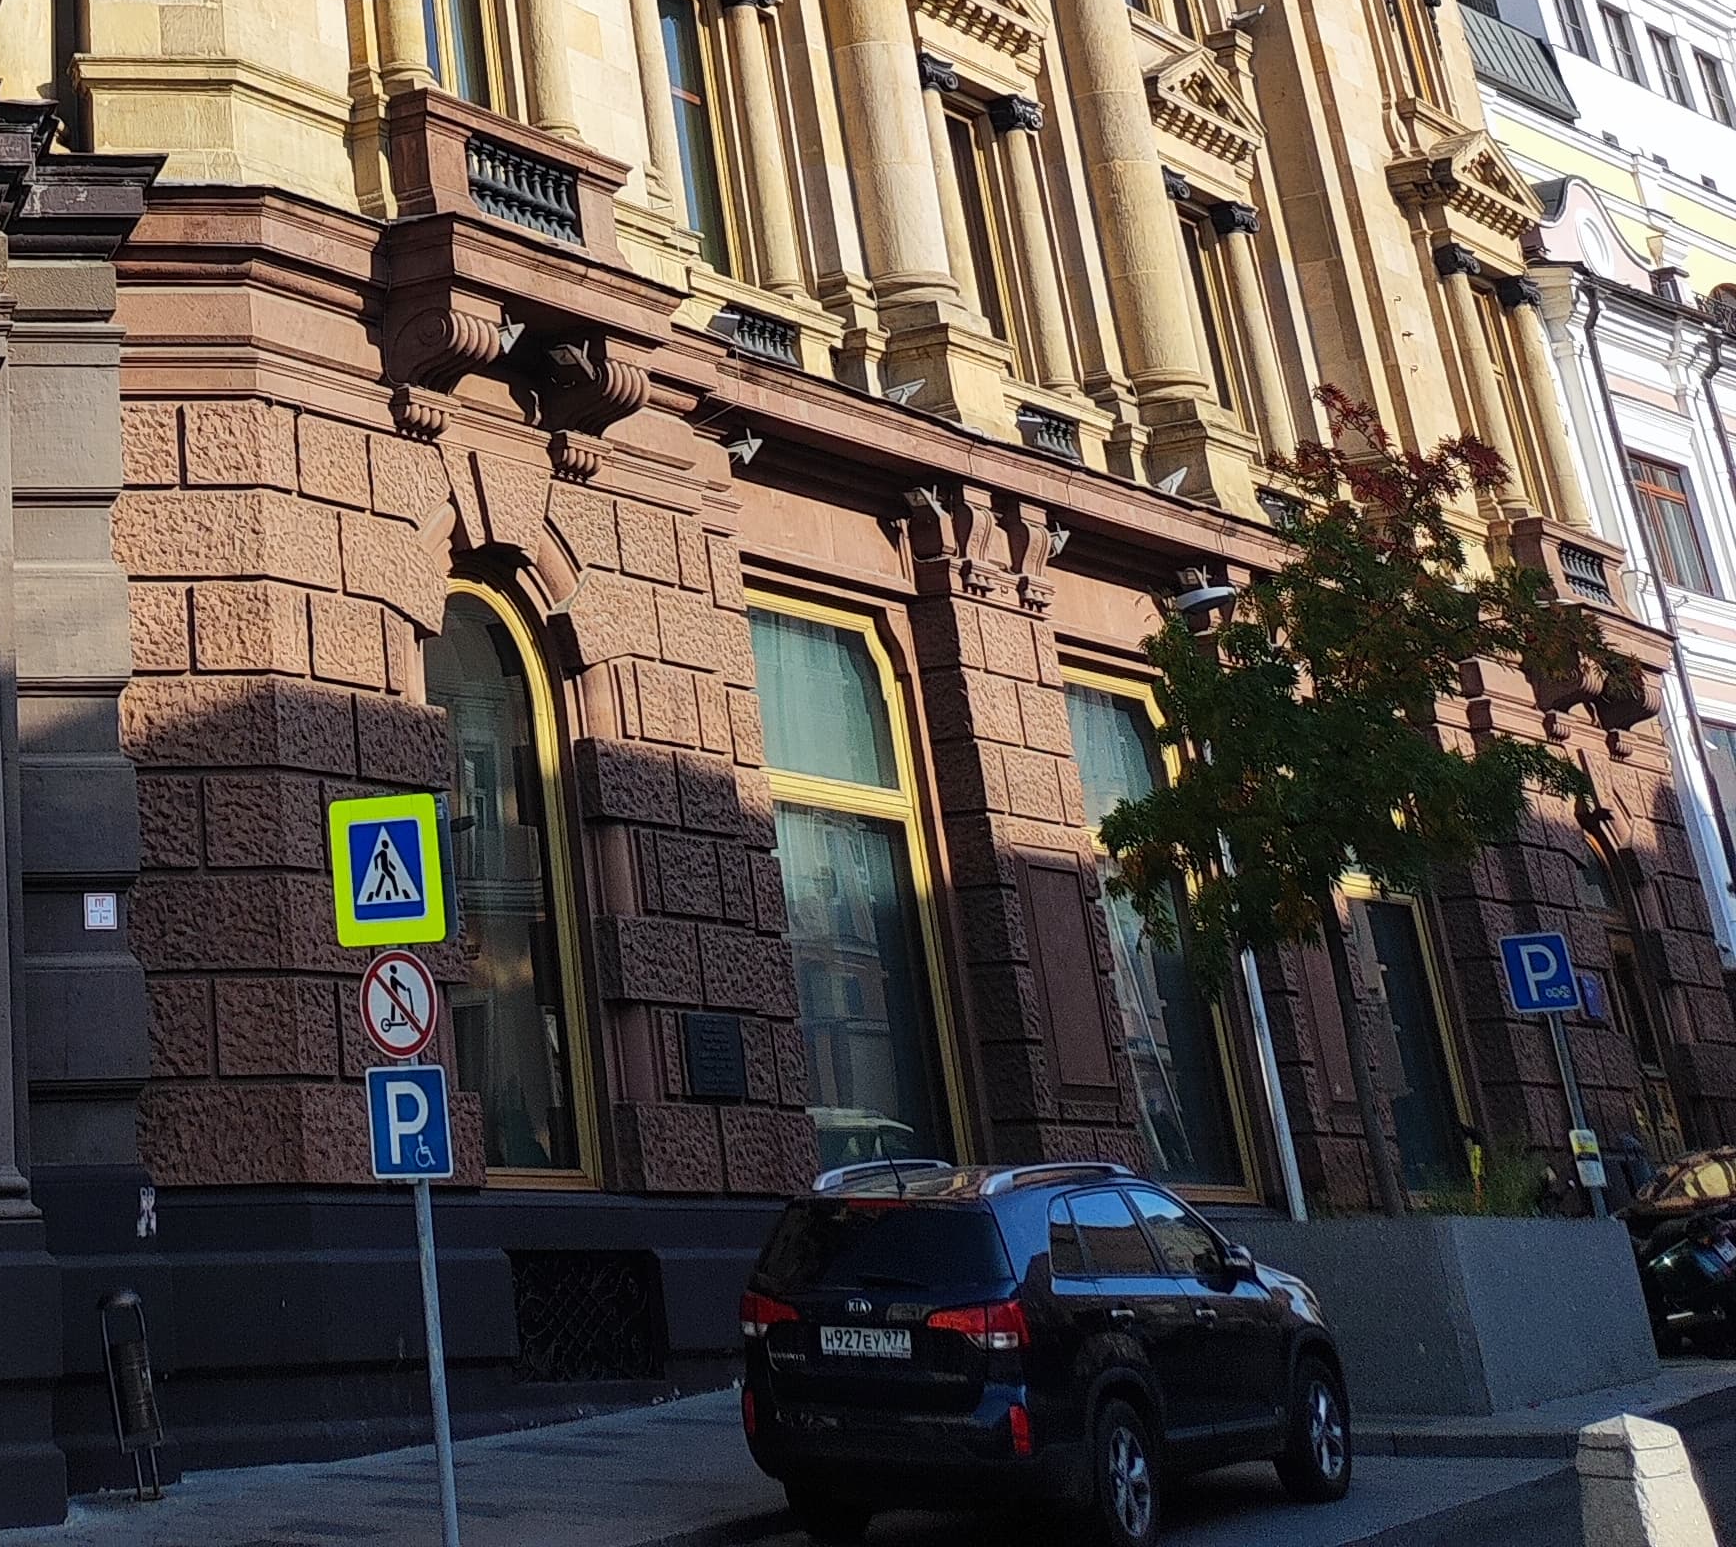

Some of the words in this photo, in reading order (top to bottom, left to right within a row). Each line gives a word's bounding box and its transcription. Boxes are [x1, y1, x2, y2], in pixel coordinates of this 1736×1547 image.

[385, 1080, 429, 1165] P
[847, 1299, 869, 1315] KIA
[884, 1329, 906, 1347] 977
